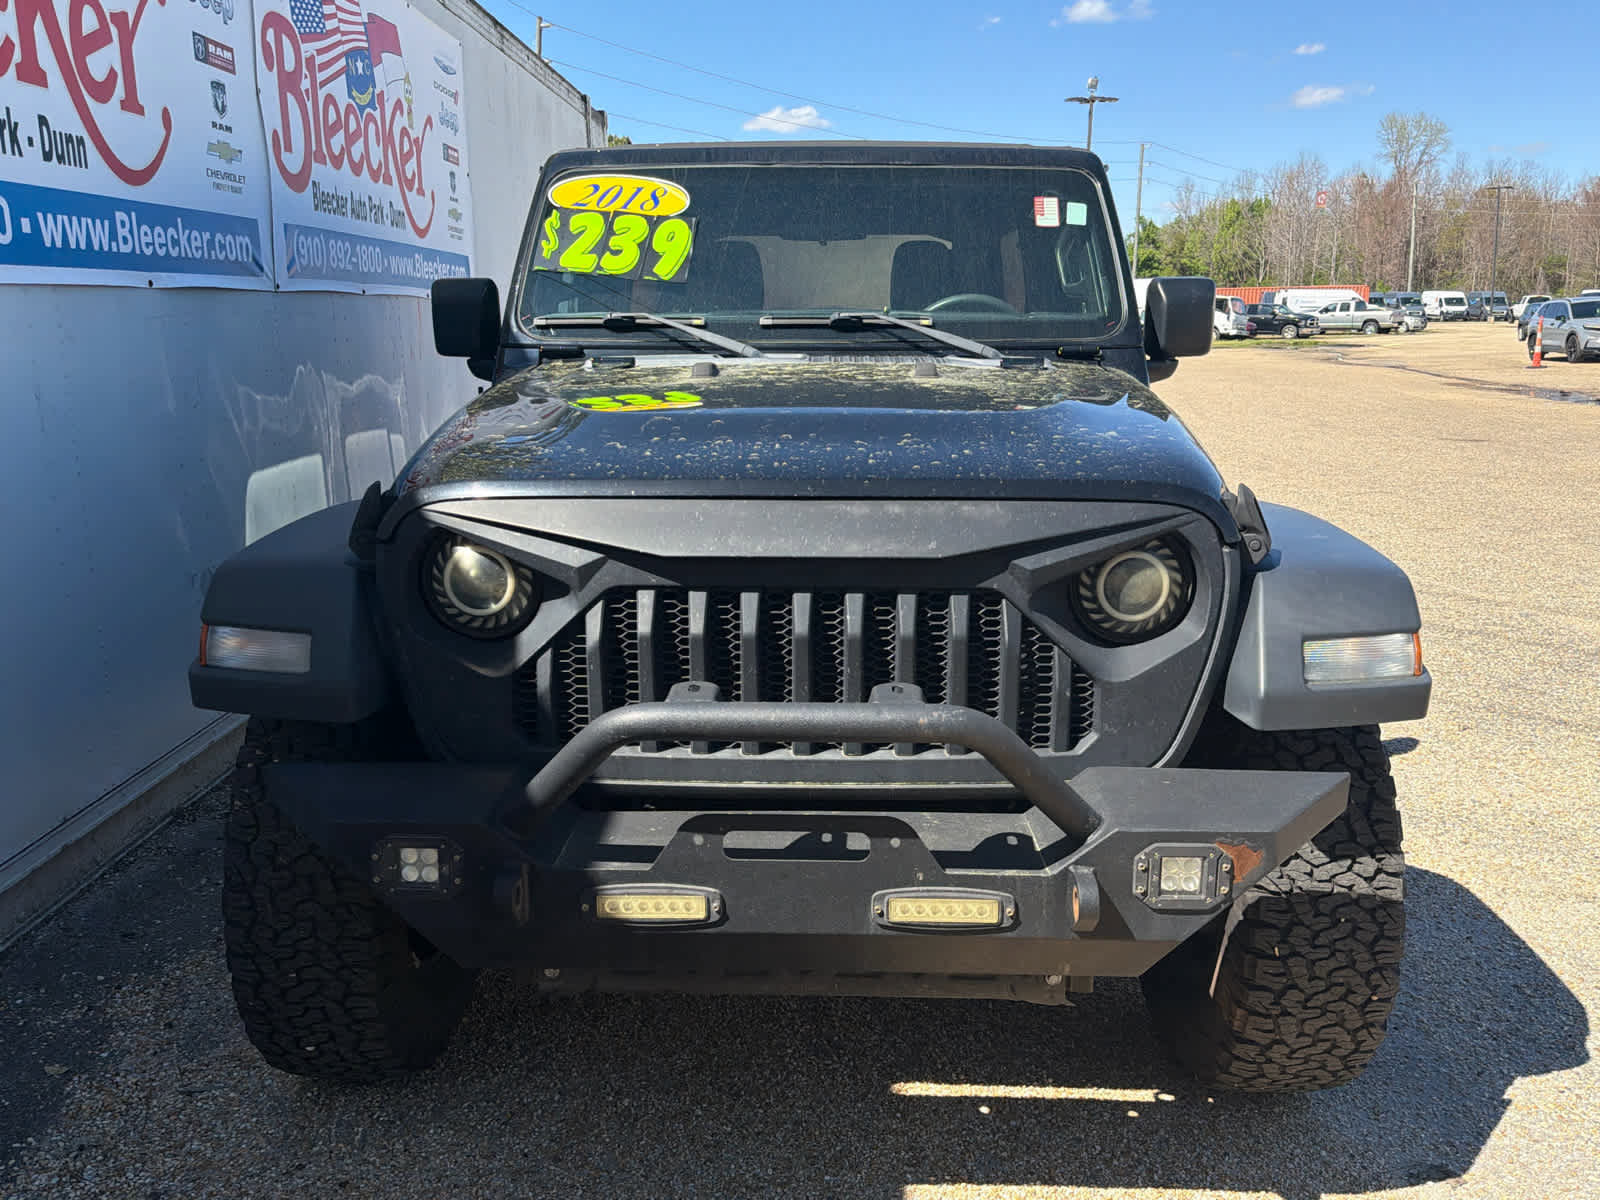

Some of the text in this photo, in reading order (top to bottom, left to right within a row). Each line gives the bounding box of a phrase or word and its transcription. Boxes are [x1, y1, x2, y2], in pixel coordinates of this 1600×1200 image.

[208, 43, 233, 61] RAM
[37, 113, 89, 169] Dunn
[211, 121, 232, 134] RAM
[261, 11, 435, 239] Bleecker
[206, 168, 246, 185] CHEVROLET
[572, 183, 669, 212] 2018
[311, 179, 407, 232] Bleecker Auto Park Dunn
[36, 211, 252, 263] www.Bleecker.com
[293, 229, 467, 280] (910) 892-1800 www.Bleecker.com
[541, 209, 692, 281] $239
